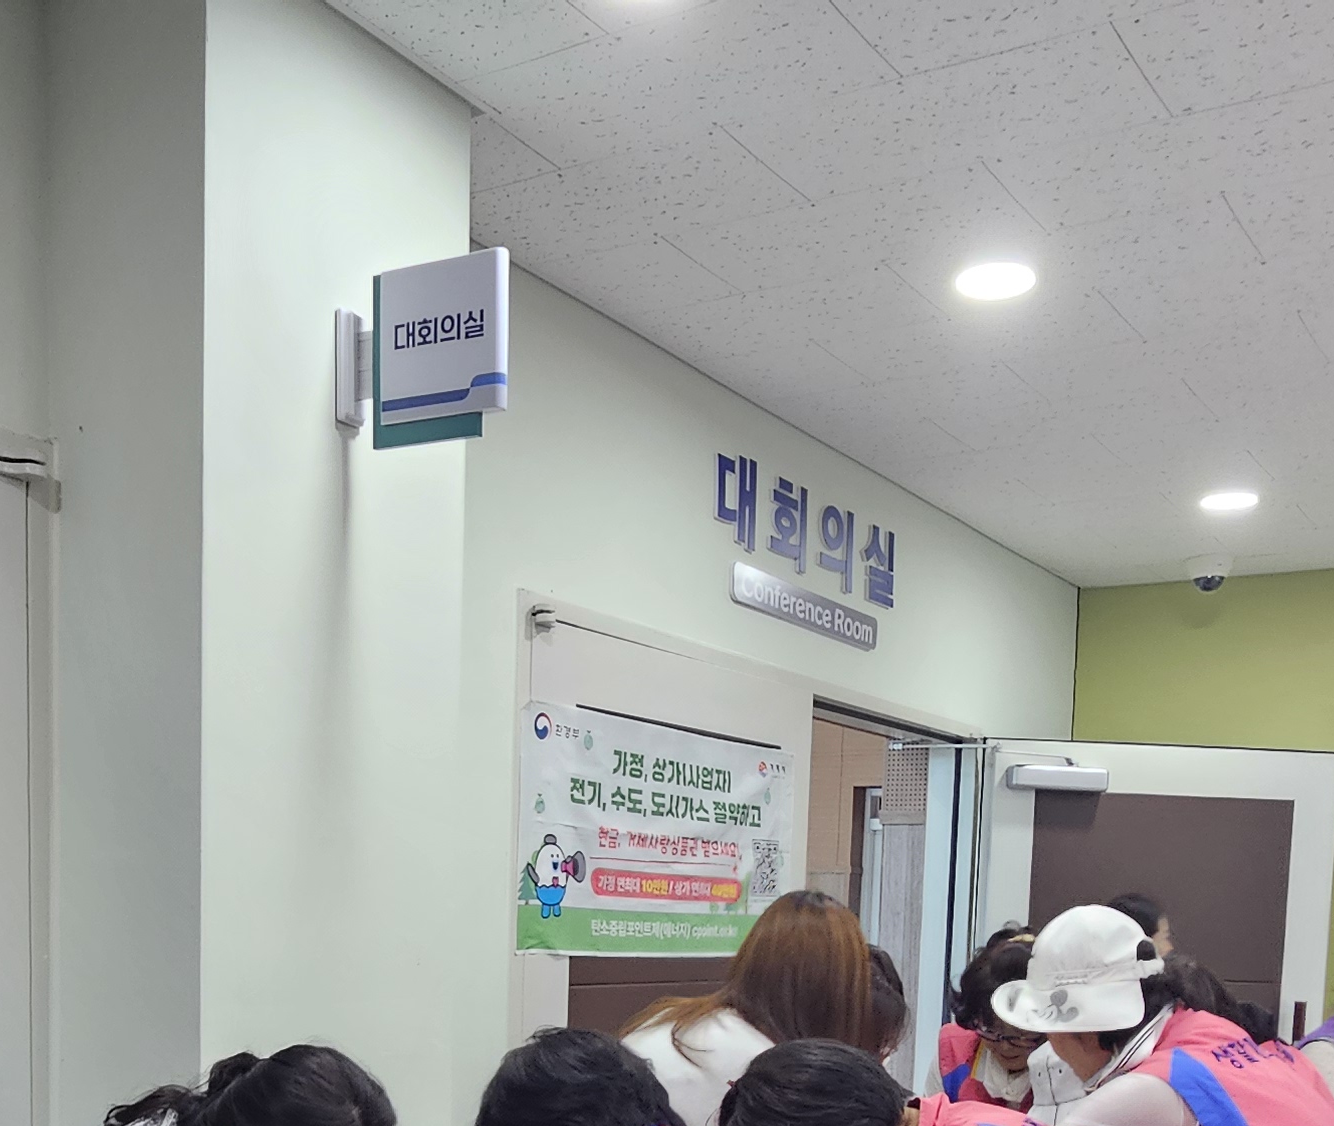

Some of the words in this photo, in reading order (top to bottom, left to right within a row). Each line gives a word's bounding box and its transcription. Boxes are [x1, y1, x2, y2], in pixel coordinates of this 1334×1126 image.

[393, 308, 485, 351] 대회의실
[713, 452, 896, 609] 대회의실
[741, 574, 832, 630] Conference
[834, 608, 873, 644] Room
[612, 749, 647, 783] 가정,
[570, 777, 606, 812] 전기,
[611, 786, 647, 817] 수도,
[651, 791, 710, 822] 도시가스
[712, 800, 761, 827] 절약하고
